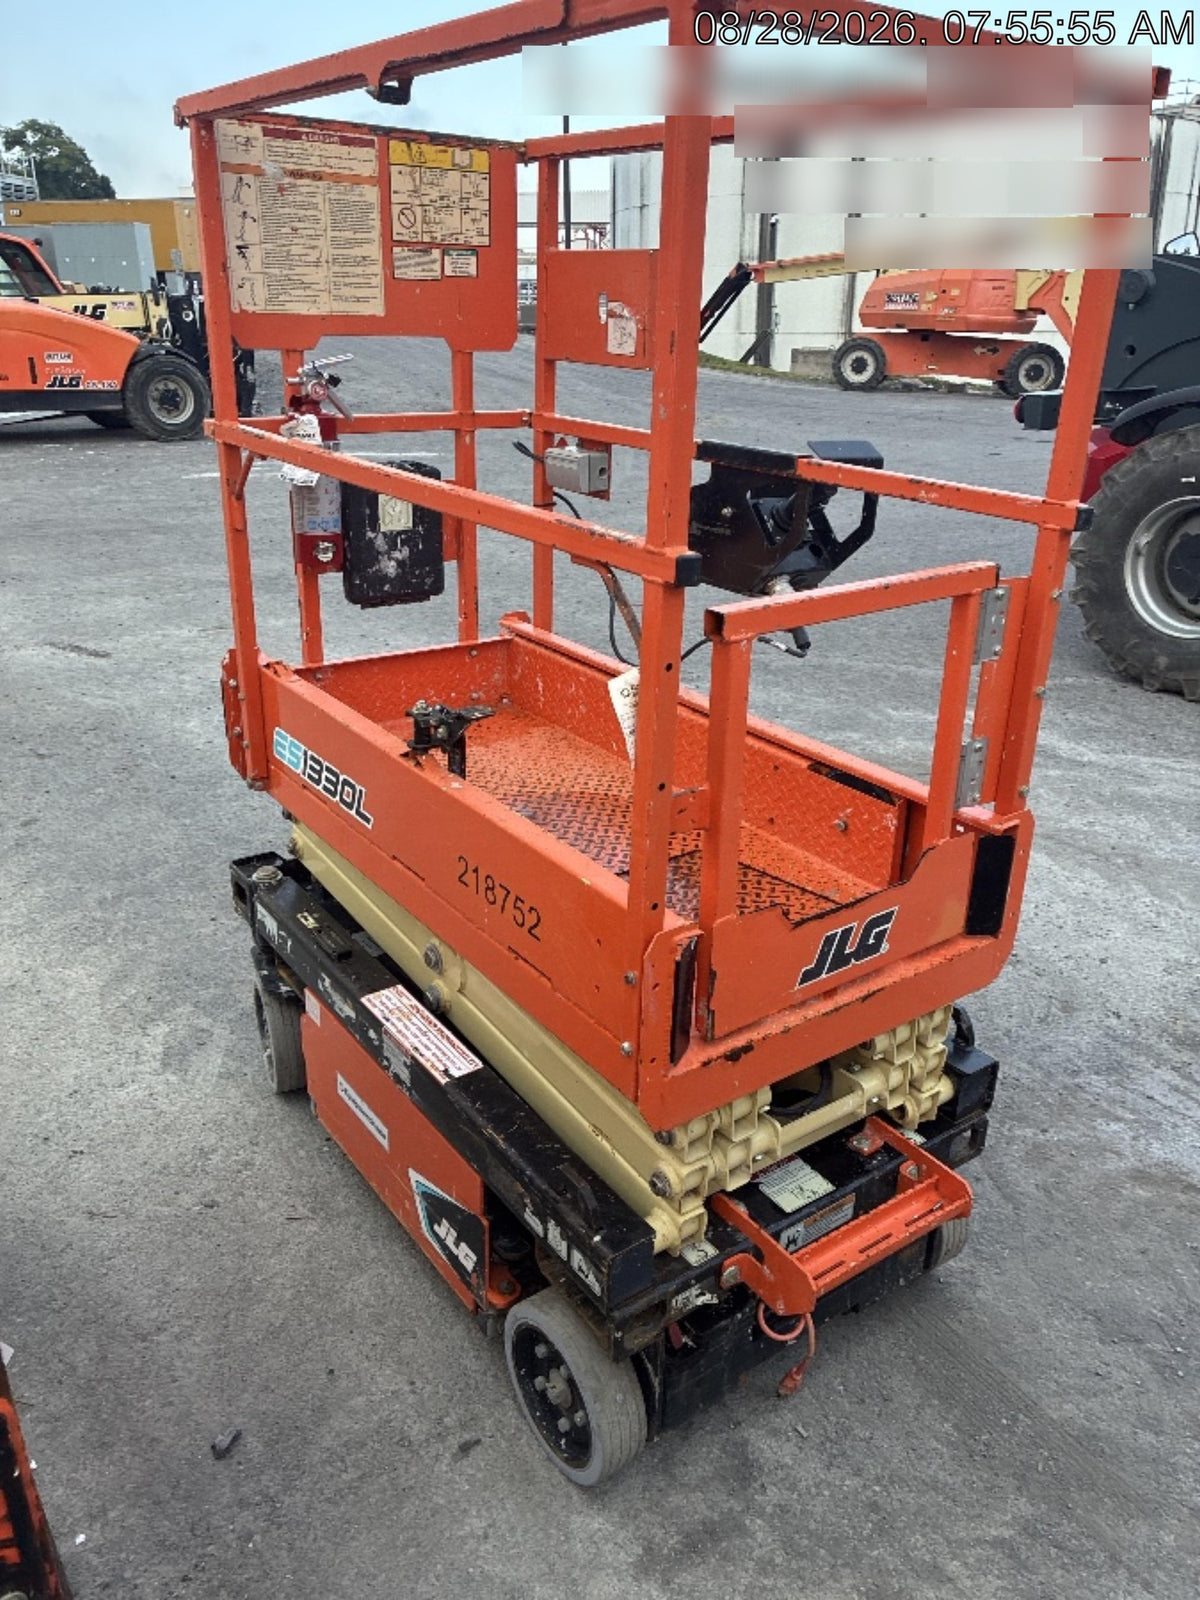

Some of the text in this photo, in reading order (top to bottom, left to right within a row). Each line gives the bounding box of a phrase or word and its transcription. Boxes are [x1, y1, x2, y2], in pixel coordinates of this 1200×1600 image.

[44, 375, 83, 389] JLG
[273, 727, 374, 830] ES1330L
[458, 854, 541, 942] 218752
[794, 906, 900, 990] JLG
[433, 1217, 478, 1274] JLG
